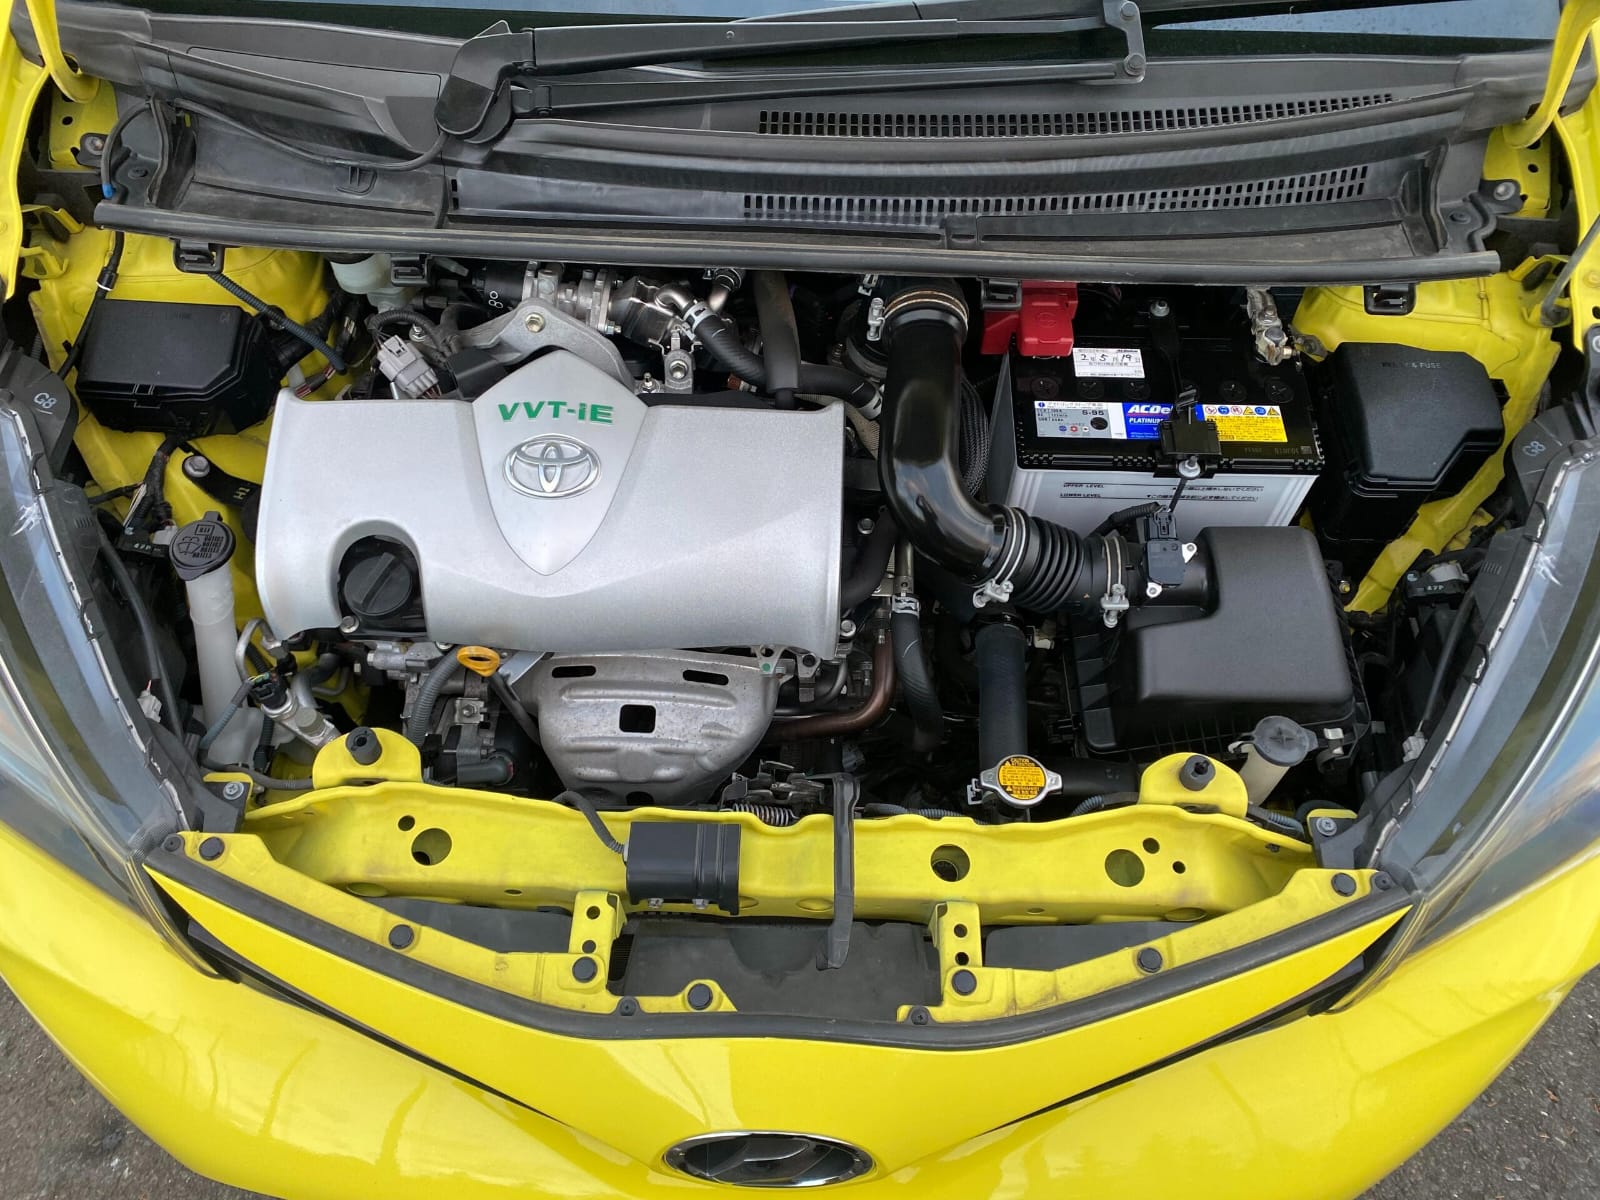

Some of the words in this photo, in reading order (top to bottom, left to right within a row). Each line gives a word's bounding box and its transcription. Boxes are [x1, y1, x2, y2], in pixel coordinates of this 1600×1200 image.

[1098, 353, 1109, 362] 5
[1120, 354, 1132, 362] 19
[498, 400, 614, 424] VVT-iE
